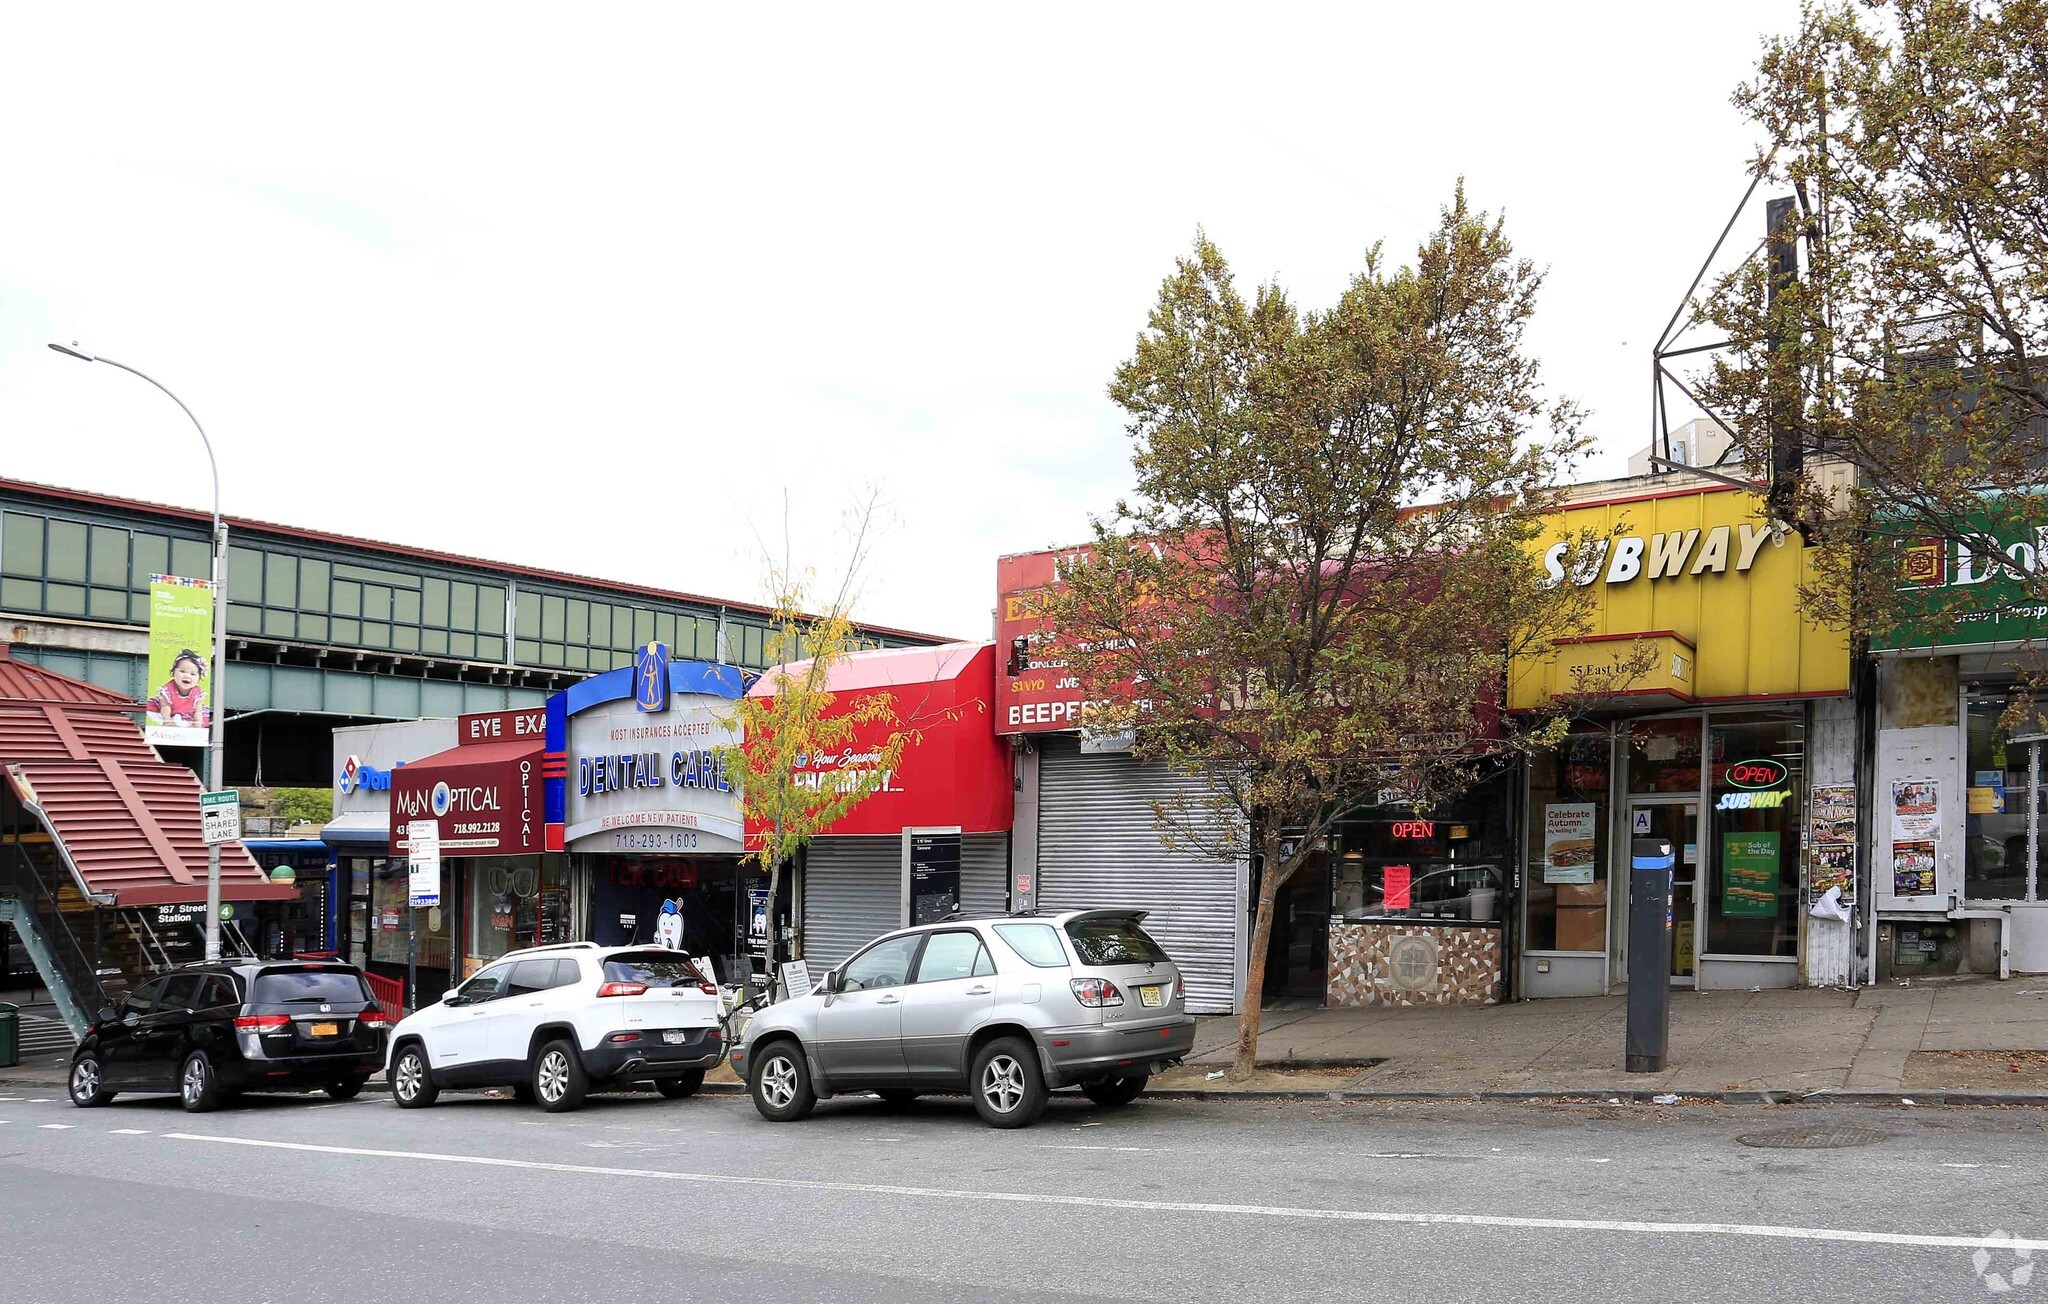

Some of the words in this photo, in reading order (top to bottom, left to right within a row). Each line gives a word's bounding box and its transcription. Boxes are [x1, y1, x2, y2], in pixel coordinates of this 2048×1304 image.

[1537, 522, 1792, 589] SUBWAY
[1569, 665, 1583, 677] 55
[1586, 664, 1611, 676] East
[1011, 679, 1046, 693] SANYO
[471, 718, 501, 738] EYE
[611, 728, 627, 740] MOST
[629, 725, 671, 739] INSURANCES
[674, 722, 710, 737] ACCEPTED
[811, 749, 839, 769] Four
[837, 748, 882, 767] Seasons
[579, 752, 660, 797] DENTAL
[670, 750, 730, 793] CARE
[1733, 765, 1778, 783] OPEN
[203, 797, 217, 805] BIKE
[218, 795, 236, 803] ROUTE
[396, 788, 429, 817] M&N
[519, 760, 531, 847] OPTICAL
[1715, 790, 1793, 810] SUBWAY
[612, 813, 646, 826] WELCOME
[648, 812, 664, 823] NEW
[666, 813, 698, 827] PATIENTS
[1548, 810, 1590, 819] Celebrate
[1636, 813, 1648, 827] A
[205, 819, 238, 830] SHARED
[396, 825, 405, 835] 43
[453, 822, 501, 834] 718.992.2128
[1392, 822, 1434, 838] OPEN
[211, 829, 233, 840] LANE
[616, 833, 697, 848] 718-293-1603
[1761, 848, 1776, 856] Day
[158, 905, 175, 914] 167
[179, 904, 207, 913] Street
[221, 907, 230, 917] 4
[158, 914, 192, 923] Station
